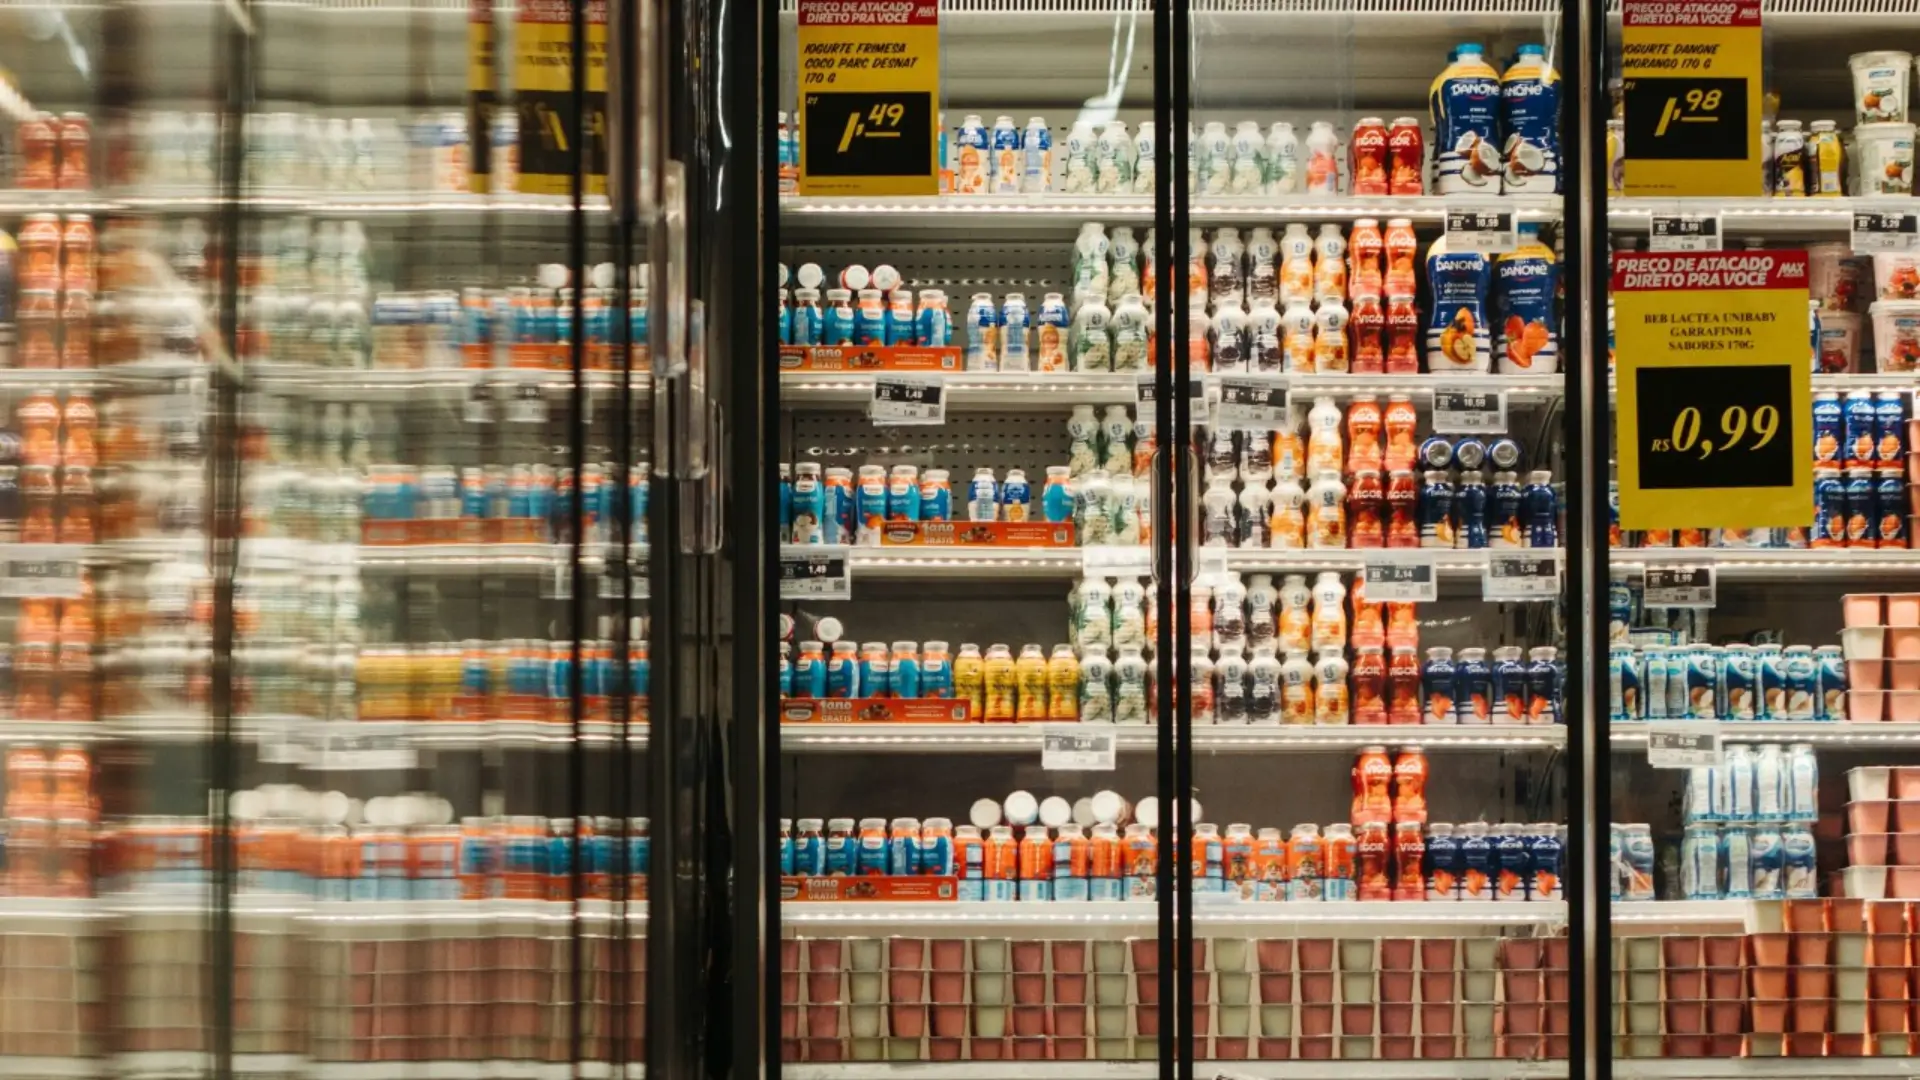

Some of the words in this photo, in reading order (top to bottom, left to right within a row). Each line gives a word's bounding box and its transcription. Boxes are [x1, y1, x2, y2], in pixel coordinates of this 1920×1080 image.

[801, 2, 839, 13] PREÇO
[842, 2, 857, 12] DE
[860, 2, 914, 12] ATACADO
[1625, 3, 1664, 14] PREÇO
[1665, 3, 1680, 13] DE
[1682, 3, 1737, 13] ATACADO
[806, 12, 850, 24] DIRETO
[851, 12, 877, 23] PRA
[1630, 13, 1674, 24] DIRETO
[1675, 13, 1699, 24] PRA
[804, 43, 854, 54] IOGURTE
[856, 43, 907, 54] FRIMESA
[1622, 43, 1671, 55] IOGURTE
[1673, 43, 1720, 54] DANONE
[804, 57, 836, 69] COCO
[838, 57, 870, 69] PARC
[871, 56, 918, 69] DESNAT
[1622, 58, 1678, 69] MORANGO
[1681, 58, 1699, 69] 170
[1703, 58, 1712, 69] G
[804, 72, 825, 84] 170
[827, 73, 836, 84] G
[1616, 257, 1671, 275] PREÇO
[1673, 257, 1695, 271] DE
[1696, 255, 1774, 271] ATACADO
[1776, 261, 1806, 278] MAX
[1623, 273, 1685, 288] DIRETO
[1686, 272, 1720, 287] PRA
[1644, 313, 1668, 324] BEB
[1671, 312, 1719, 324] LACTEA
[1722, 311, 1776, 323] UNIBABY
[1670, 326, 1752, 337] GARRAFINHA
[1668, 340, 1724, 351] SABORES
[1728, 339, 1754, 350] 170G
[1672, 404, 1780, 461] 0,99
